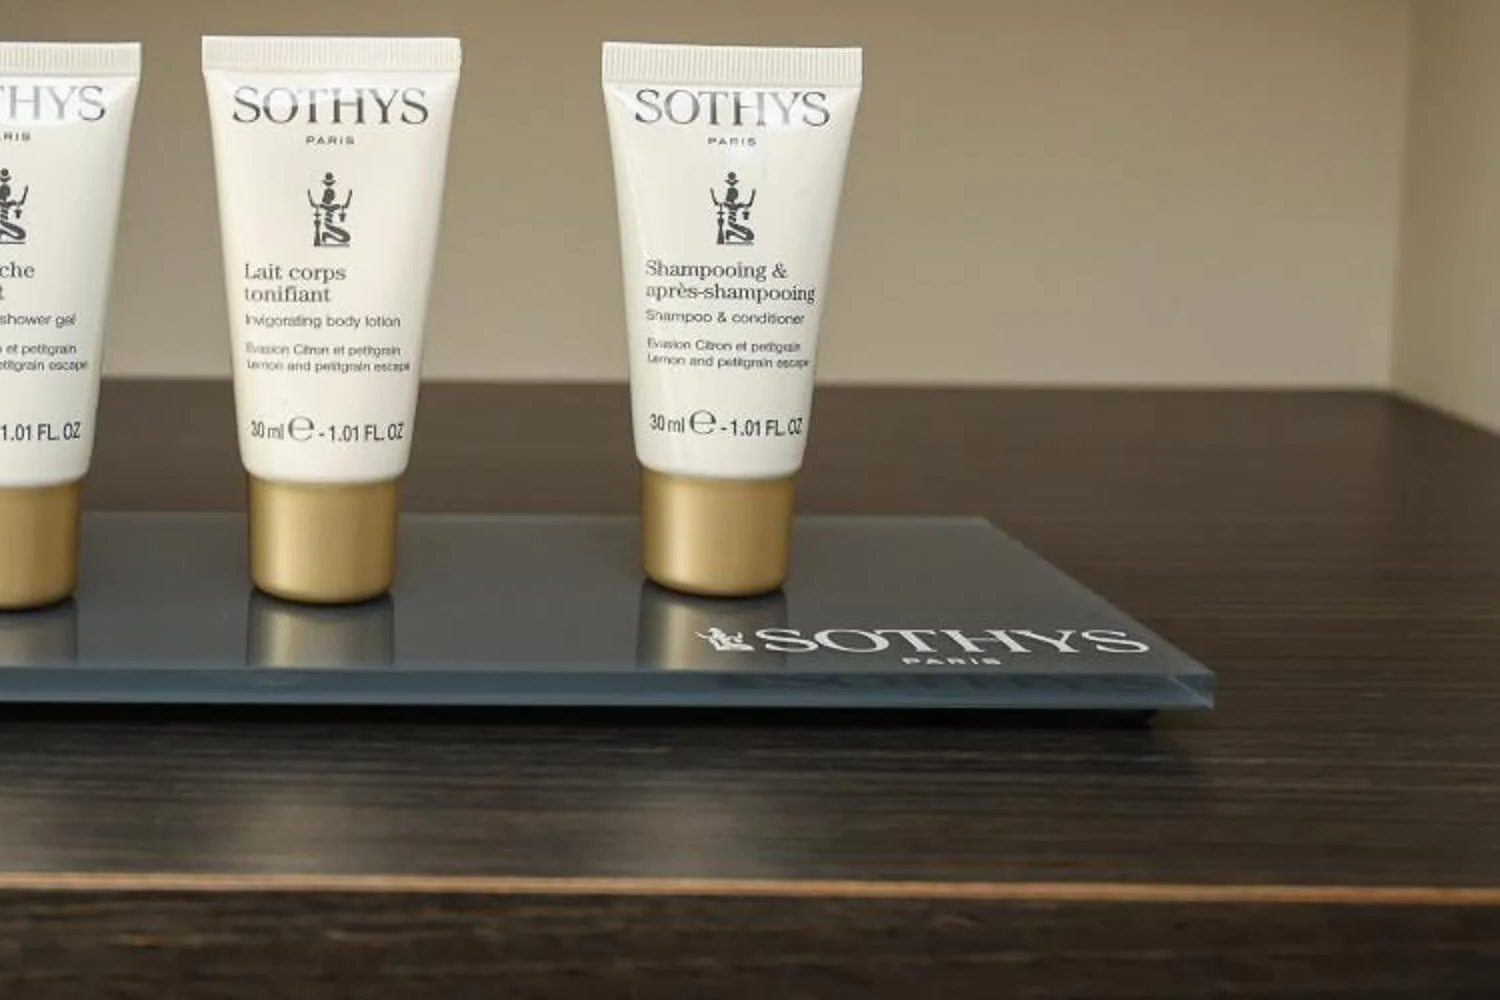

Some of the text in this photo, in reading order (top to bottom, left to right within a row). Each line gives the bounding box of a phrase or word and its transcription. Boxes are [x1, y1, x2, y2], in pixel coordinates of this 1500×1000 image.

[232, 85, 429, 125] SOTHYS
[635, 89, 830, 127] SOTHYS
[305, 135, 355, 145] PARIS
[708, 137, 757, 146] PARIS
[244, 263, 347, 284] Lait corps
[645, 259, 788, 281] Shampooing &
[245, 285, 332, 303] tonifiant
[646, 283, 815, 304] après-shampooing
[0, 313, 51, 325] shower
[55, 314, 76, 328] gel
[327, 315, 360, 330] body
[366, 315, 401, 327] lotion
[646, 309, 805, 324] Shampoo & conditioner
[287, 361, 311, 371] and
[690, 355, 713, 366] and
[2, 423, 31, 441] 1.01
[251, 420, 265, 439] 30
[267, 423, 284, 440] ml
[328, 424, 359, 442] 1.01
[650, 413, 665, 432] 30
[667, 417, 685, 434] ml
[731, 419, 761, 437] 1.01
[755, 628, 1150, 654] SOTHYS
[901, 657, 1002, 665] PARIS
